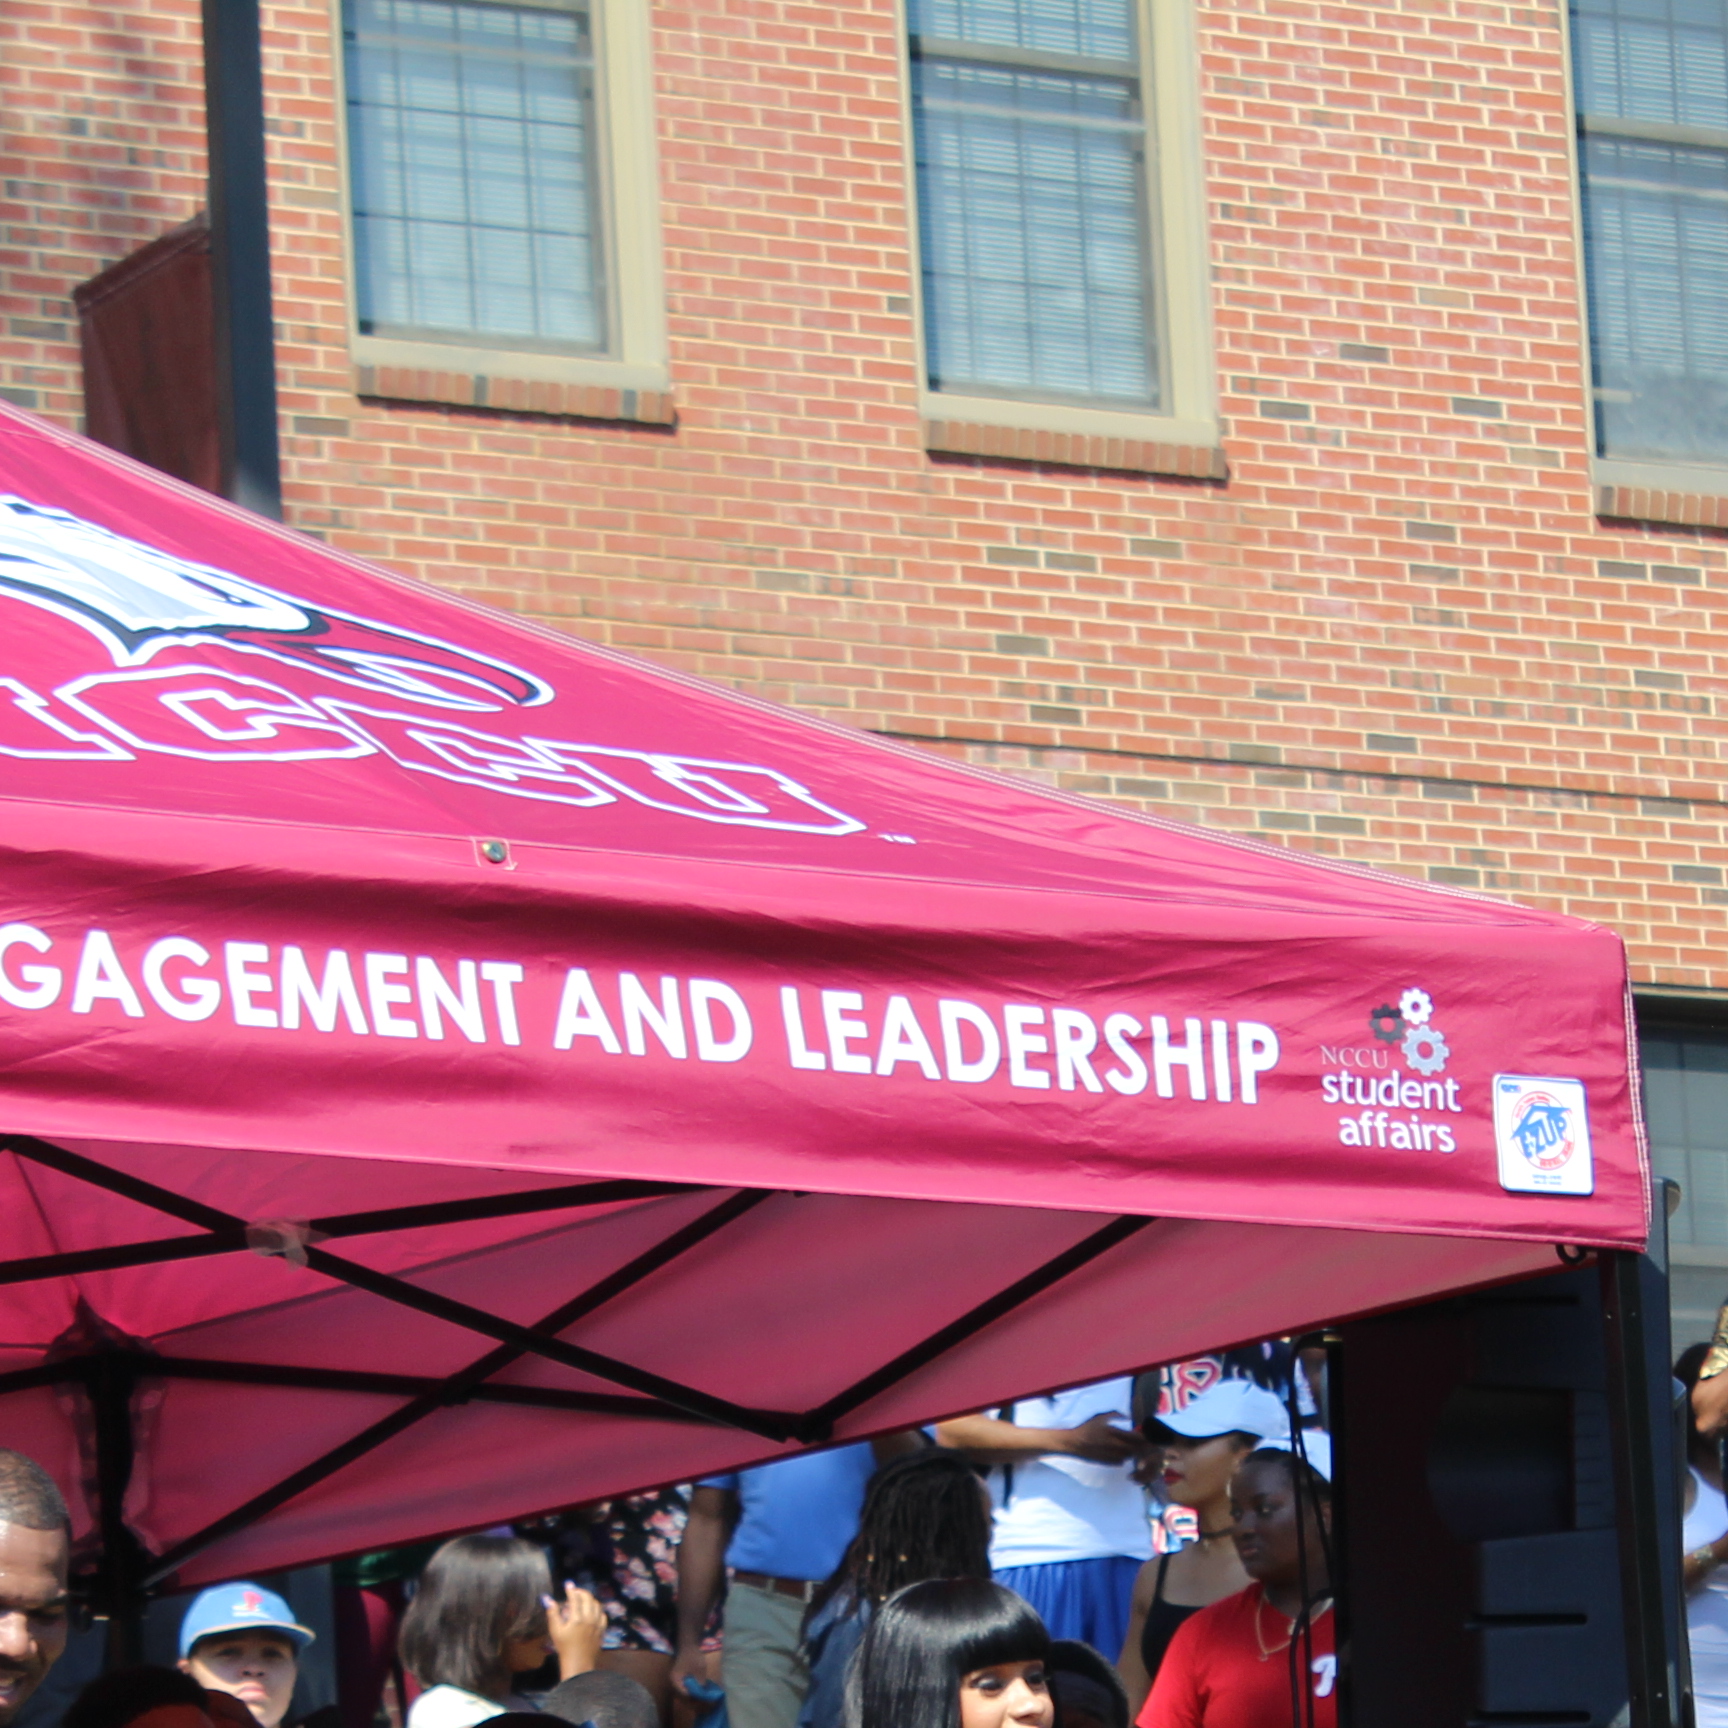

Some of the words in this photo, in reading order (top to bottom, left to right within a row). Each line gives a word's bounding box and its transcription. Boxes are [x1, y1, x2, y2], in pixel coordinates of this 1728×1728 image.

[552, 968, 754, 1063] AND
[779, 985, 1280, 1105] LEADERSHIP
[1320, 1044, 1389, 1069] NCCU
[1320, 1069, 1464, 1113] student
[1338, 1110, 1457, 1154] affairs
